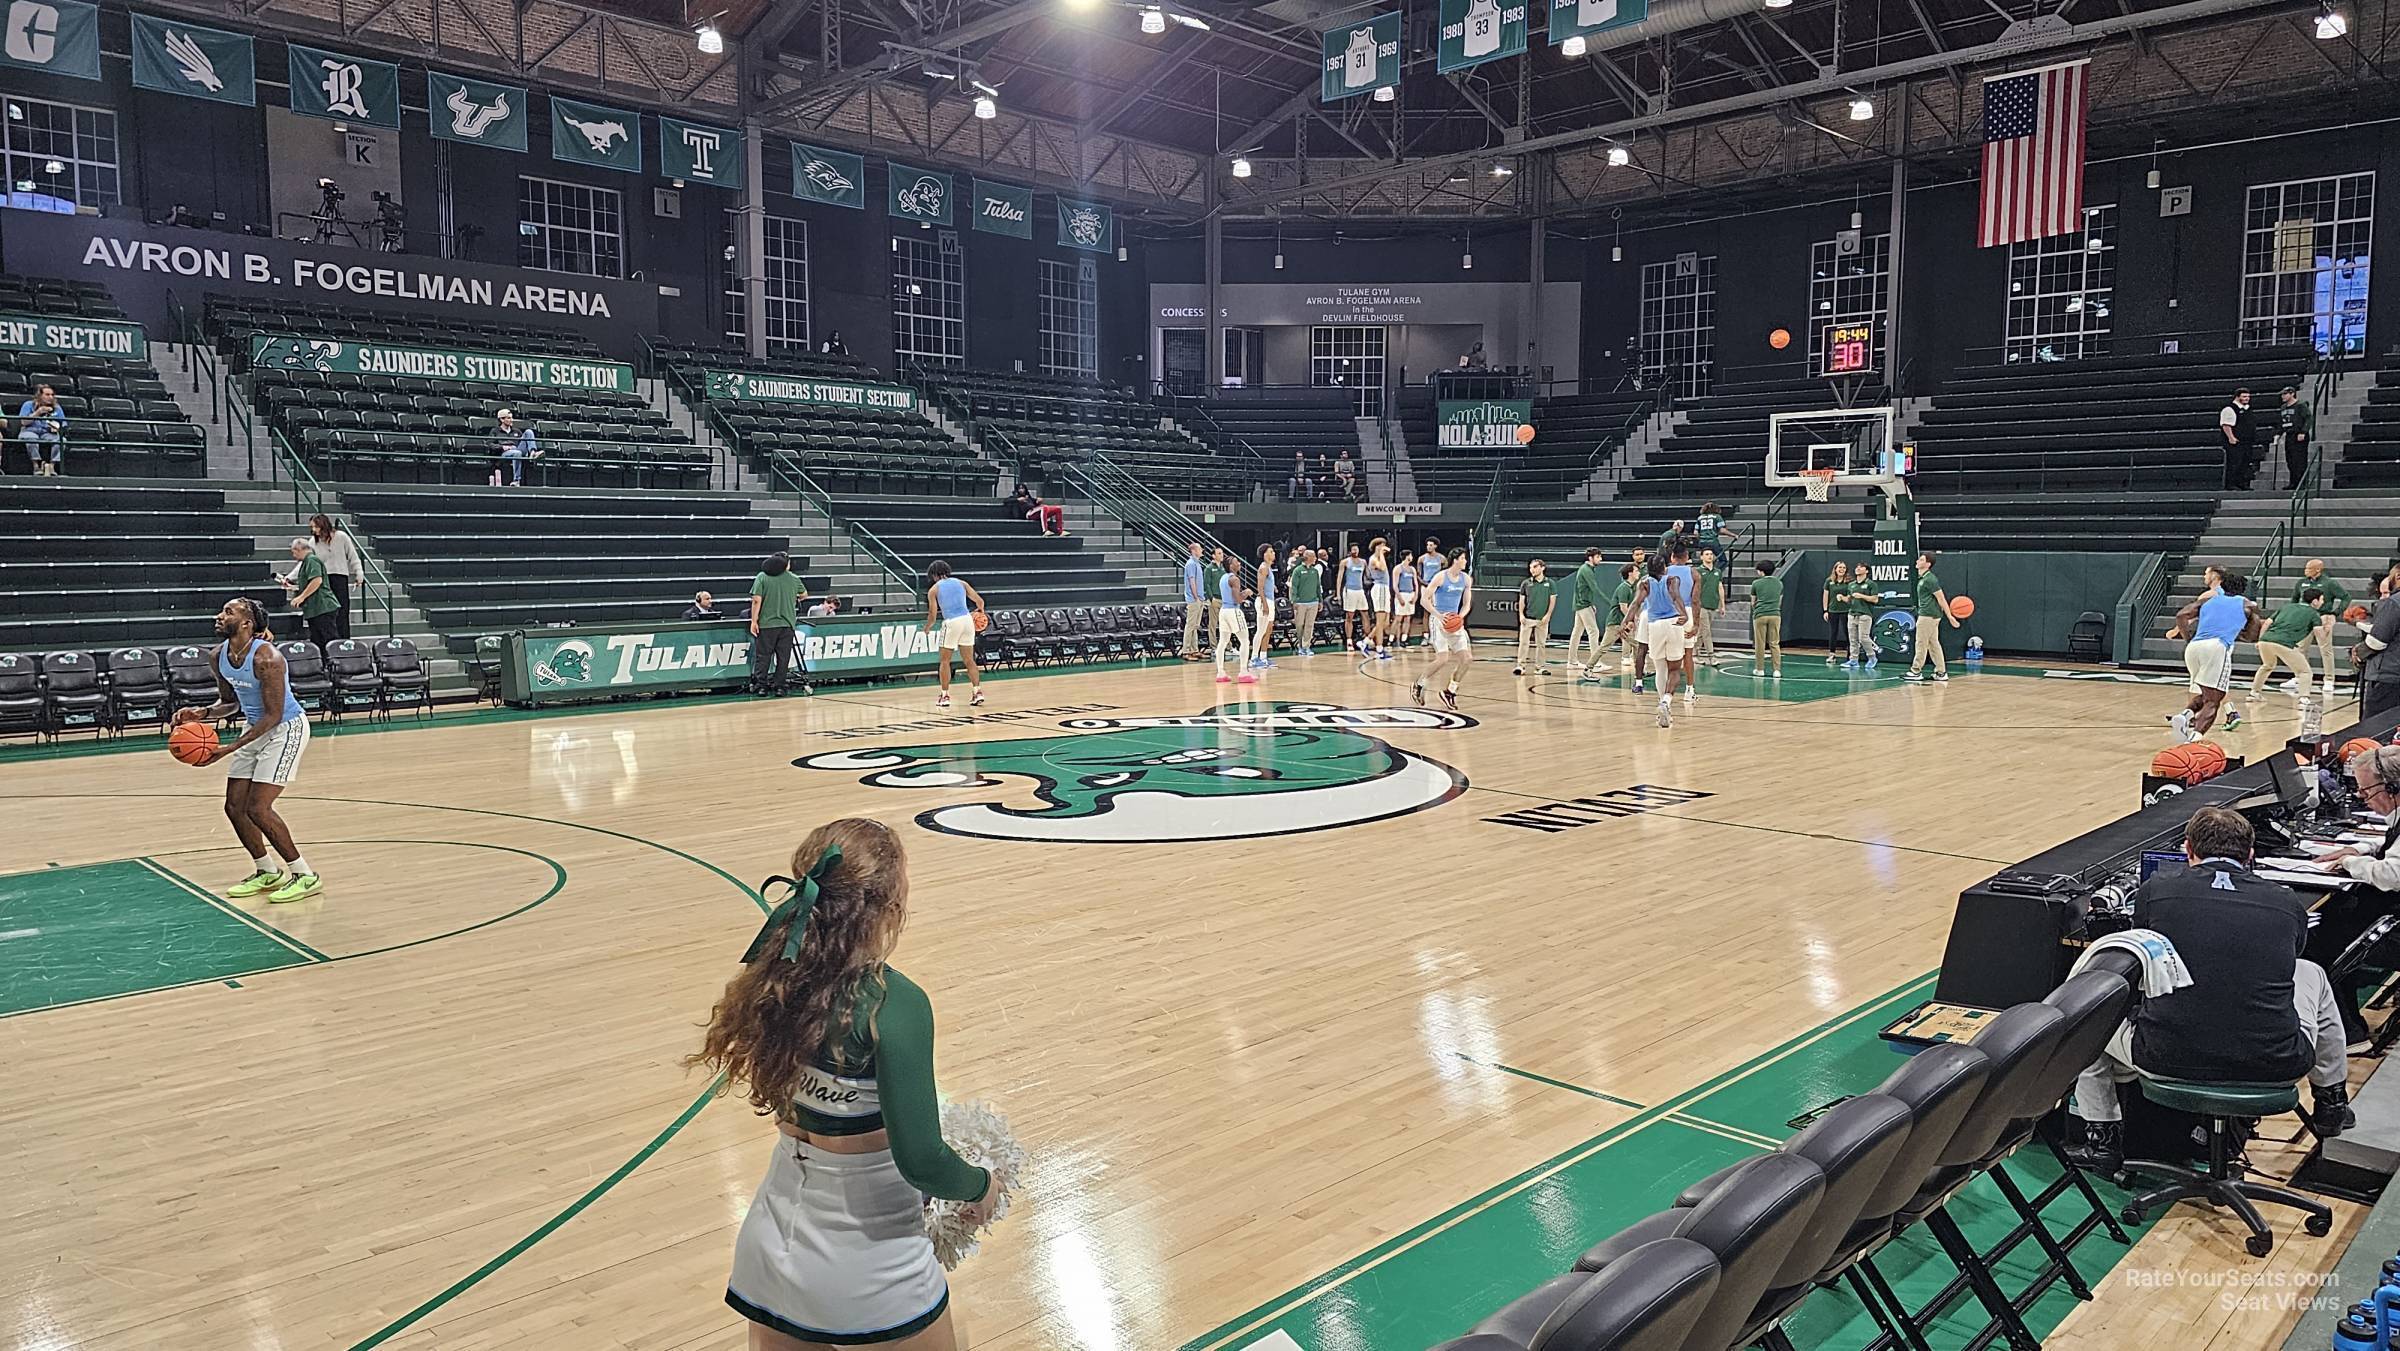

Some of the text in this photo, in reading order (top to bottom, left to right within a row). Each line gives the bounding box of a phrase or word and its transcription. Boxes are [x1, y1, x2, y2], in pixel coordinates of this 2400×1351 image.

[1502, 5, 1525, 25] 1983
[1442, 22, 1463, 41] 1980
[1475, 19, 1489, 37] 33
[1378, 41, 1397, 58] 1969
[1326, 55, 1345, 72] 1967
[1355, 52, 1367, 69] 31
[355, 144, 371, 164] K
[663, 198, 673, 214] L
[982, 197, 1024, 222] Tulsa
[2170, 197, 2182, 212] P
[942, 239, 955, 252] M
[1841, 239, 1854, 253] O
[1083, 265, 1092, 279] N
[1681, 260, 1691, 274] N
[82, 236, 611, 318] AVRON B. FOGELMAN ARENA
[1306, 296, 1421, 305] AVRON B. FOGELMAN ARENA
[1338, 288, 1390, 296] TULANE GYM
[1322, 314, 1405, 322] DEVLIN FIELDHOUSE
[0, 321, 132, 353] ENT SECTION
[1833, 327, 1869, 343] 19:44
[1832, 342, 1864, 369] 30
[358, 348, 618, 389] SAUNDERS STUDENT SECTION
[749, 379, 911, 408] SAUNDERS STUDENT SECTION
[1185, 504, 1229, 512] FRERET STREET
[1365, 505, 1433, 513] NEWCOMB PLACE
[1700, 519, 1714, 530] 23
[1874, 539, 1907, 556] ROLL
[1870, 565, 1910, 581] WAVE
[1486, 600, 1519, 611] SECTIO
[606, 633, 751, 685] TULANE
[880, 624, 941, 660] WAV
[1479, 784, 1720, 833] DEVLIN
[2211, 870, 2237, 891] A
[799, 1070, 860, 1103] Wave
